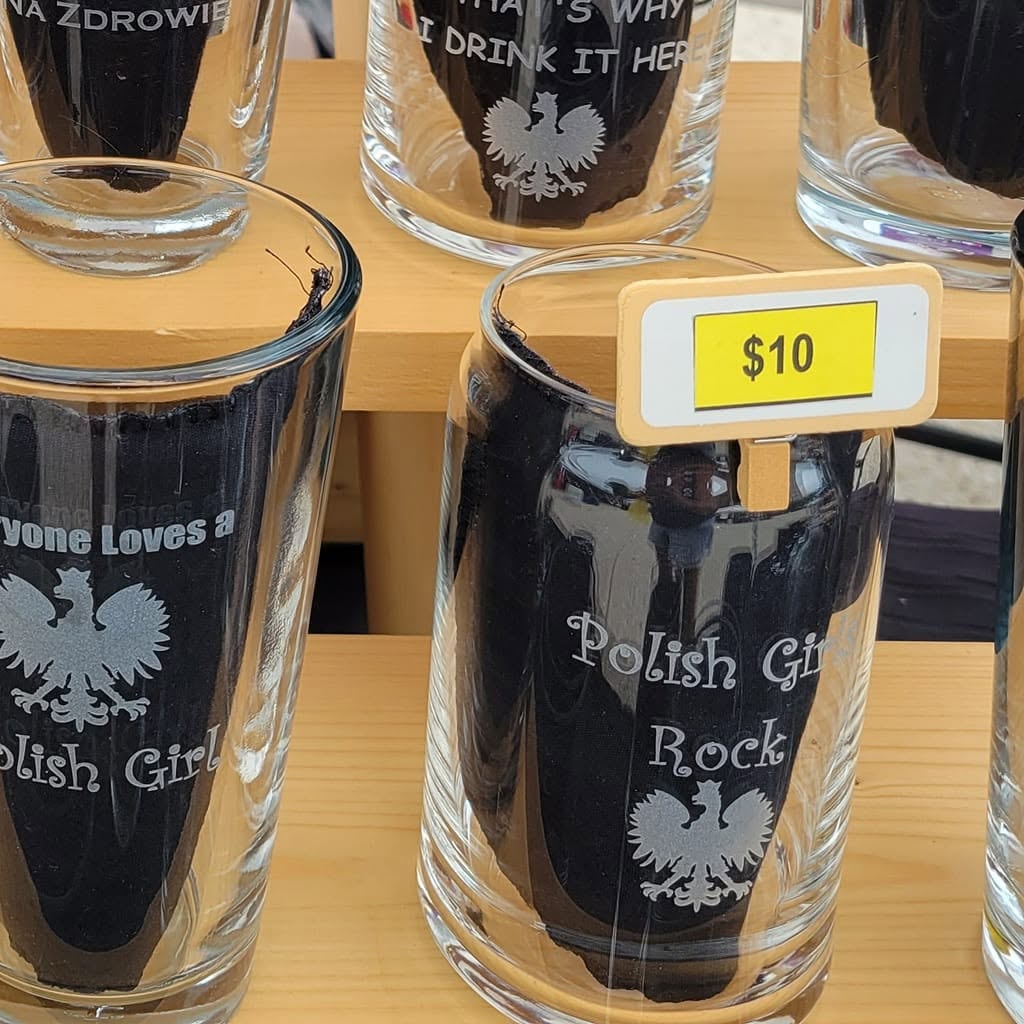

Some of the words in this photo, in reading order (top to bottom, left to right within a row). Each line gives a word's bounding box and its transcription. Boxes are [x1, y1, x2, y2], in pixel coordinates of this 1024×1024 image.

[56, 0, 230, 32] ZDROWIE
[419, 16, 434, 43] I
[445, 26, 557, 73] DRINK
[572, 48, 619, 74] IT
[742, 333, 814, 381] $10
[101, 518, 208, 556] Loves
[215, 509, 235, 538] a
[566, 611, 736, 690] Polish
[125, 724, 221, 792] Girl
[649, 718, 787, 777] Rock
